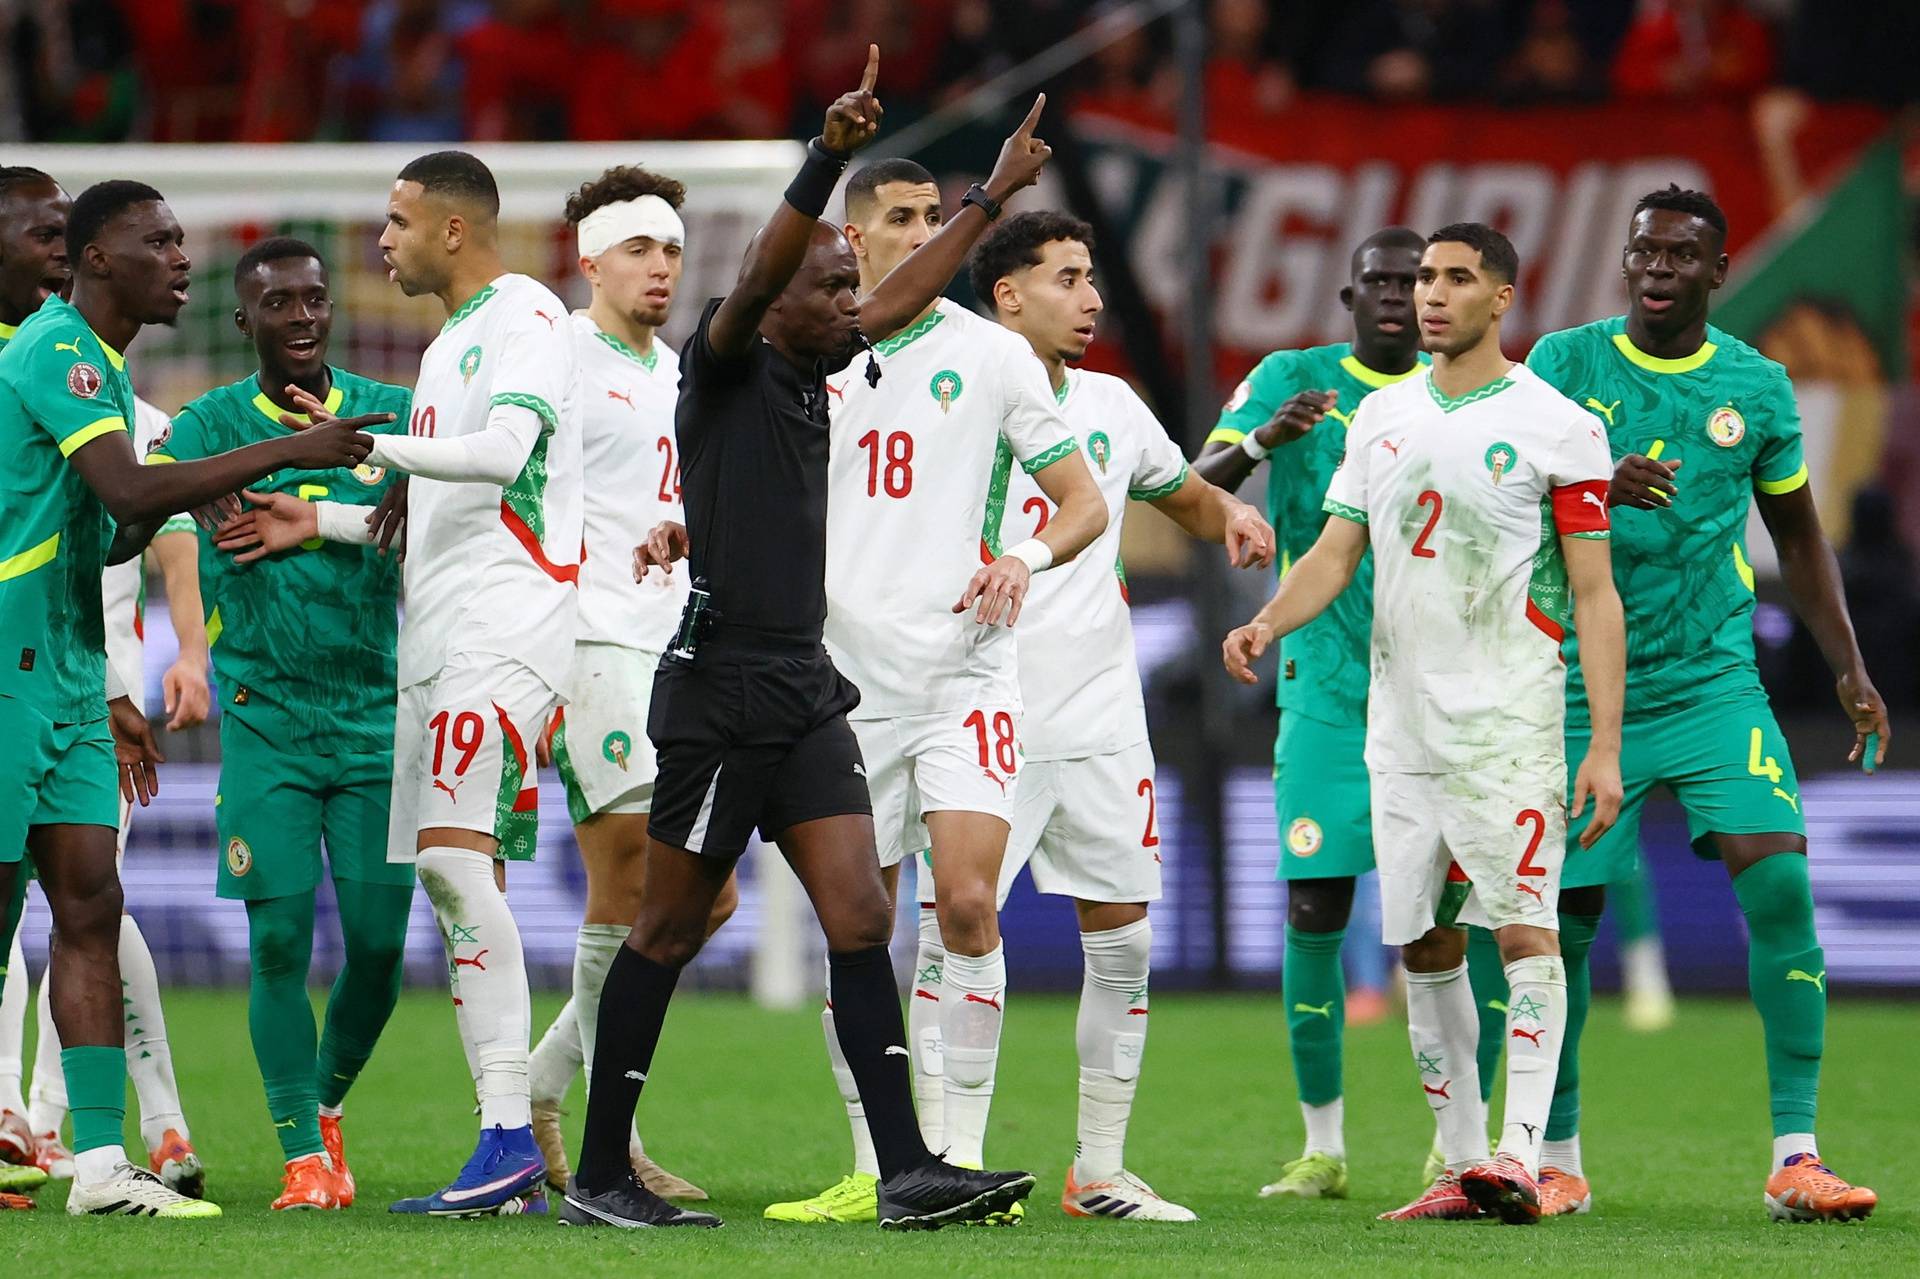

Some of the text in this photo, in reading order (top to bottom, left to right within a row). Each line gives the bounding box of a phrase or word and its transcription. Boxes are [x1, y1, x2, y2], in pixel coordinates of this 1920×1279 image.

[857, 429, 914, 499] 18
[1413, 489, 1443, 559] 2
[429, 710, 485, 777] 19
[962, 709, 1017, 775] 18
[1748, 727, 1784, 784] 4
[1515, 808, 1547, 877] 2
